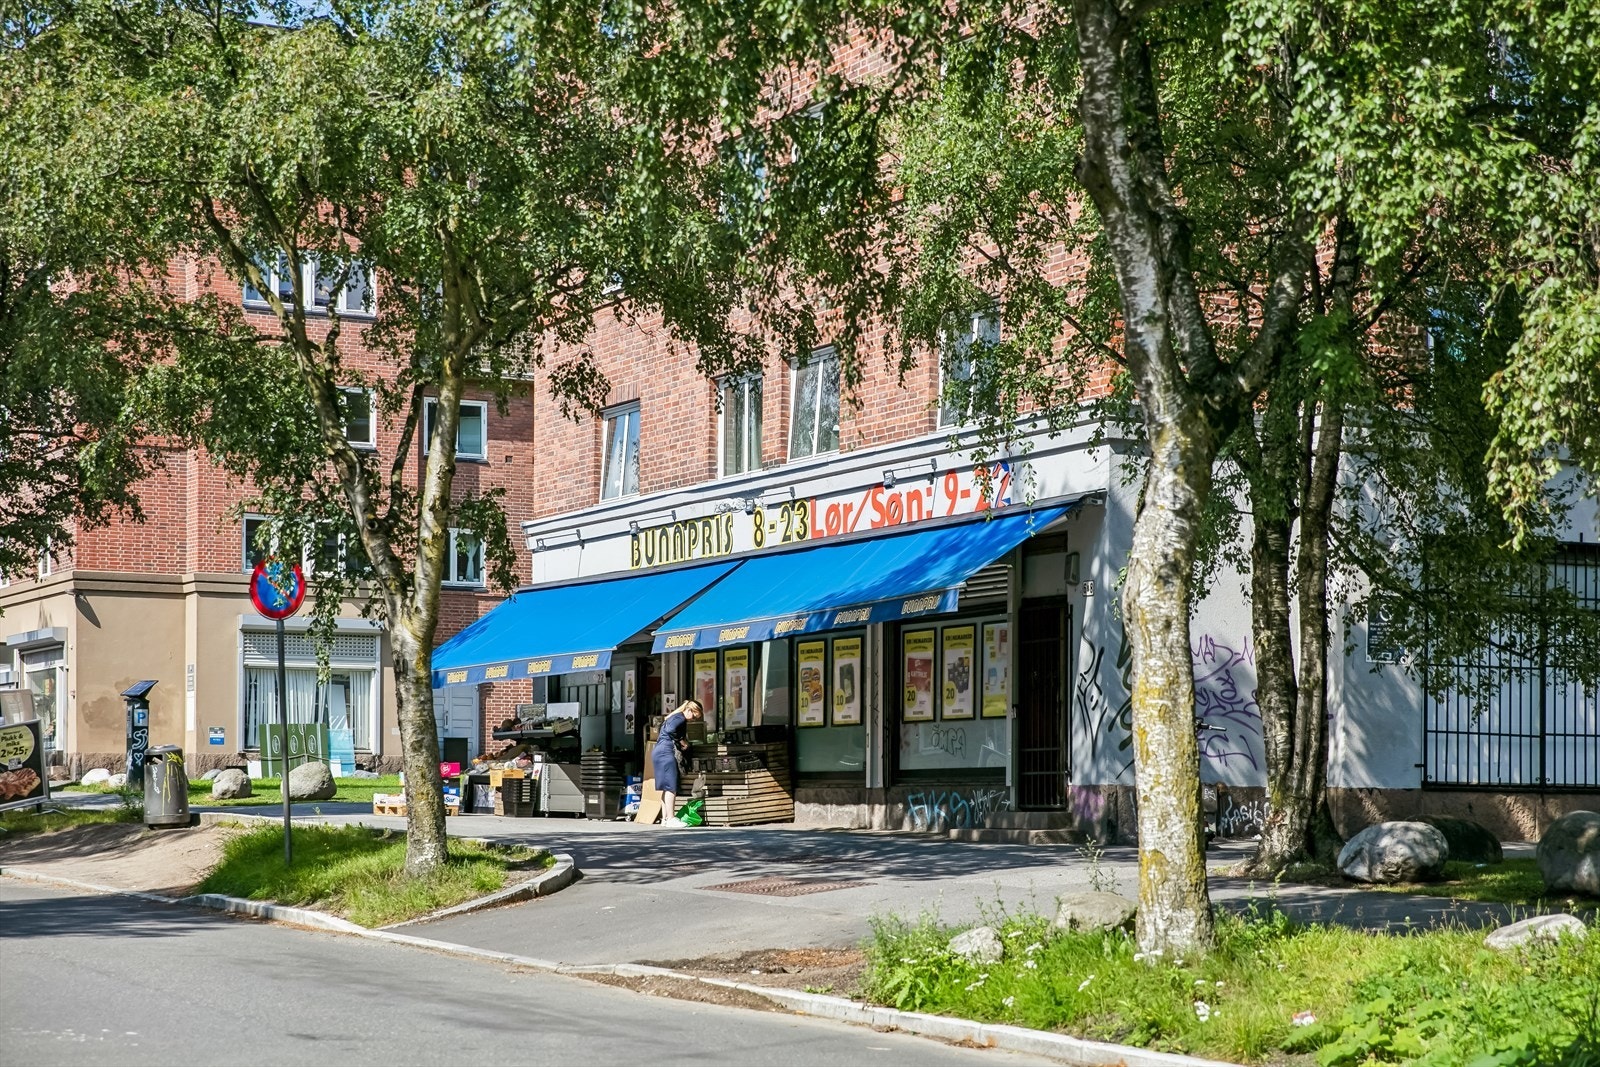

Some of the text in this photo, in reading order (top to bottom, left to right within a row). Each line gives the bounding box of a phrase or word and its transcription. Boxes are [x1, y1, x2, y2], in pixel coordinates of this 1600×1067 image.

[630, 512, 733, 570] BUNNPRIS
[753, 498, 809, 549] 8-23
[810, 484, 933, 540] Lør/Søn:
[907, 690, 916, 701] 20
[946, 688, 955, 700] 20
[836, 695, 844, 706] 10
[137, 711, 146, 724] P
[1, 749, 7, 758] 2
